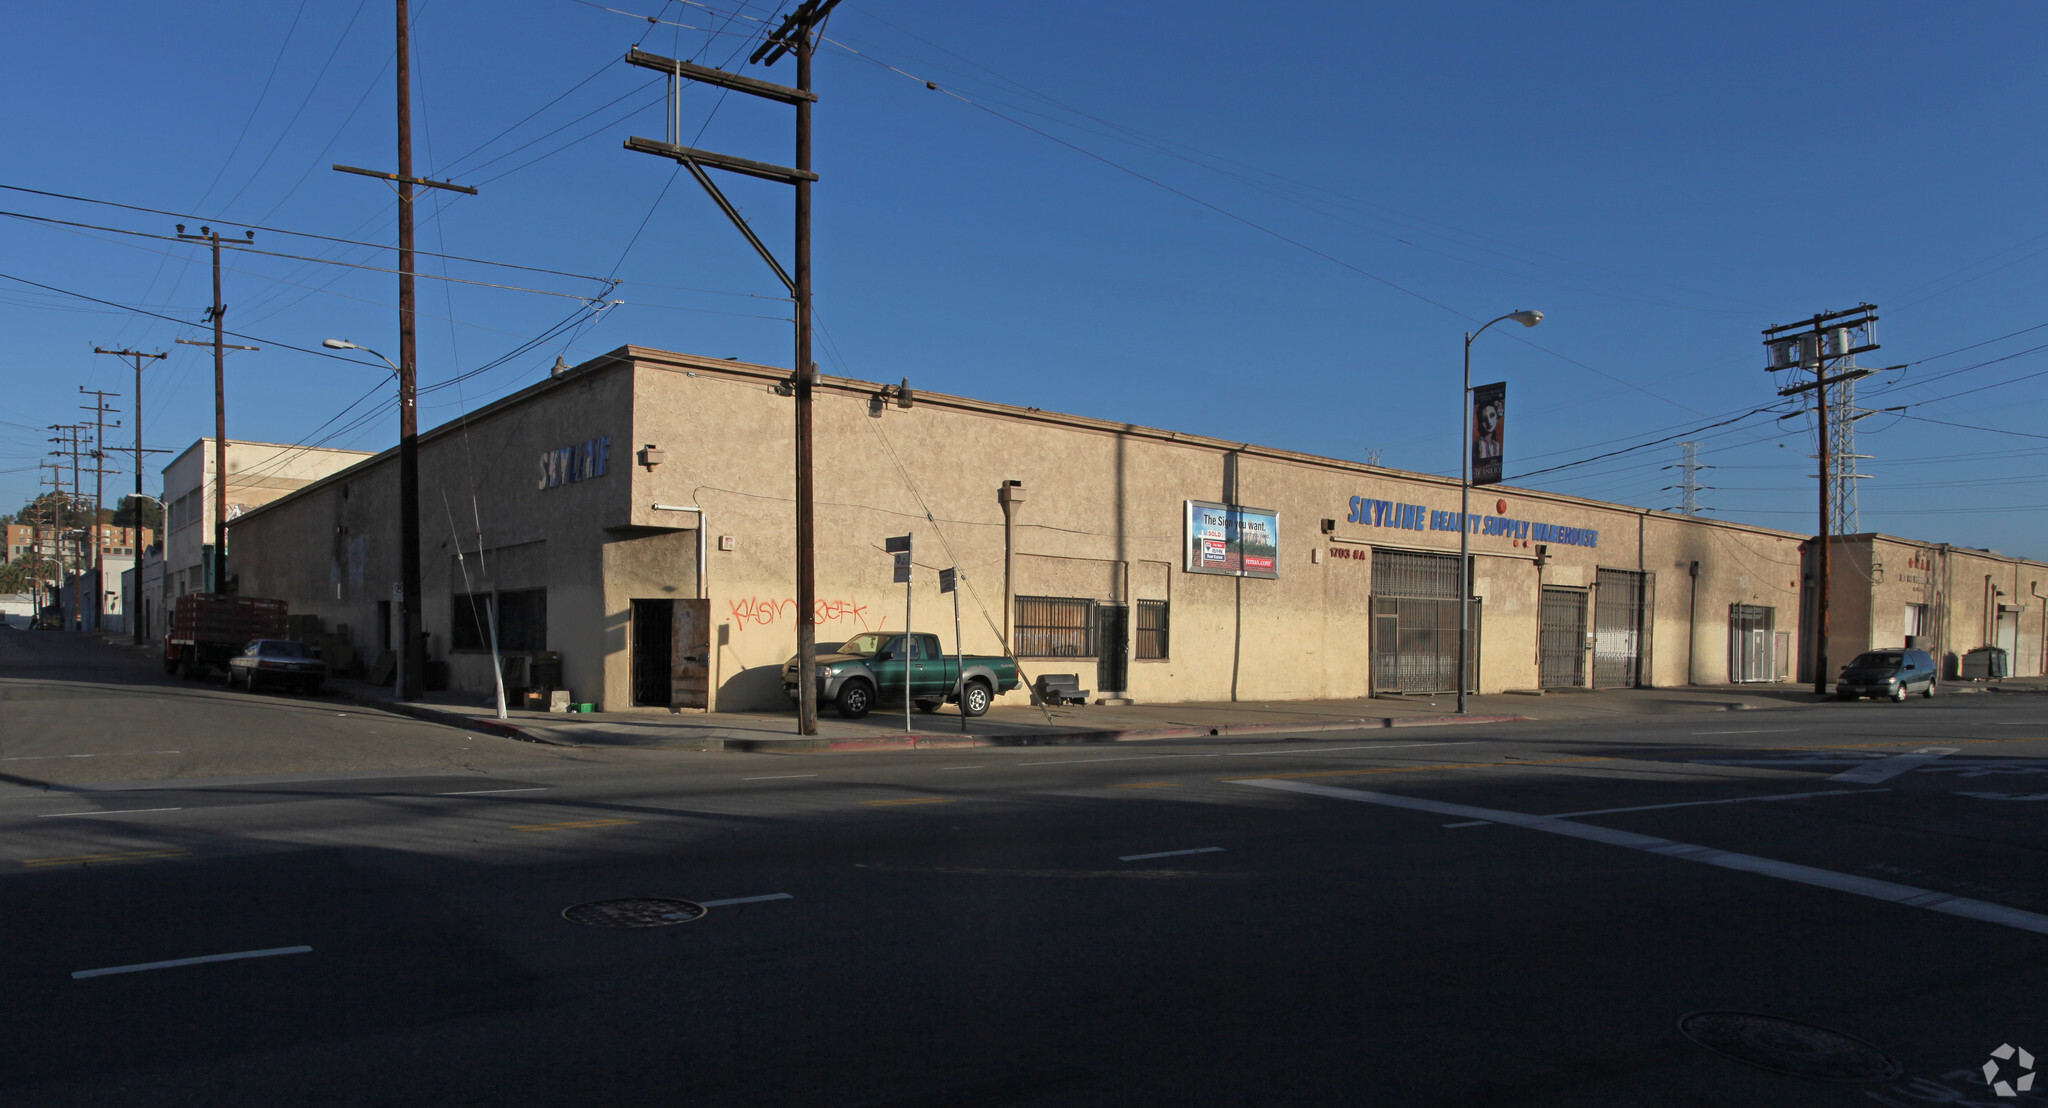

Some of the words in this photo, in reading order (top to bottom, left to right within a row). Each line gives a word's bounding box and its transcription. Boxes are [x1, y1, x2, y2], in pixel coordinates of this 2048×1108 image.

[538, 436, 612, 491] SKYLINE
[1204, 514, 1217, 525] The
[1217, 515, 1233, 529] Sign
[1234, 520, 1247, 530] you
[1347, 495, 1427, 532] SKYLINE
[1430, 509, 1482, 534] BEAUTY
[1482, 515, 1531, 540] SUPPLY
[1532, 522, 1599, 548] WAREHOUSE
[1208, 530, 1222, 538] SOLD
[1329, 547, 1351, 559] 1703
